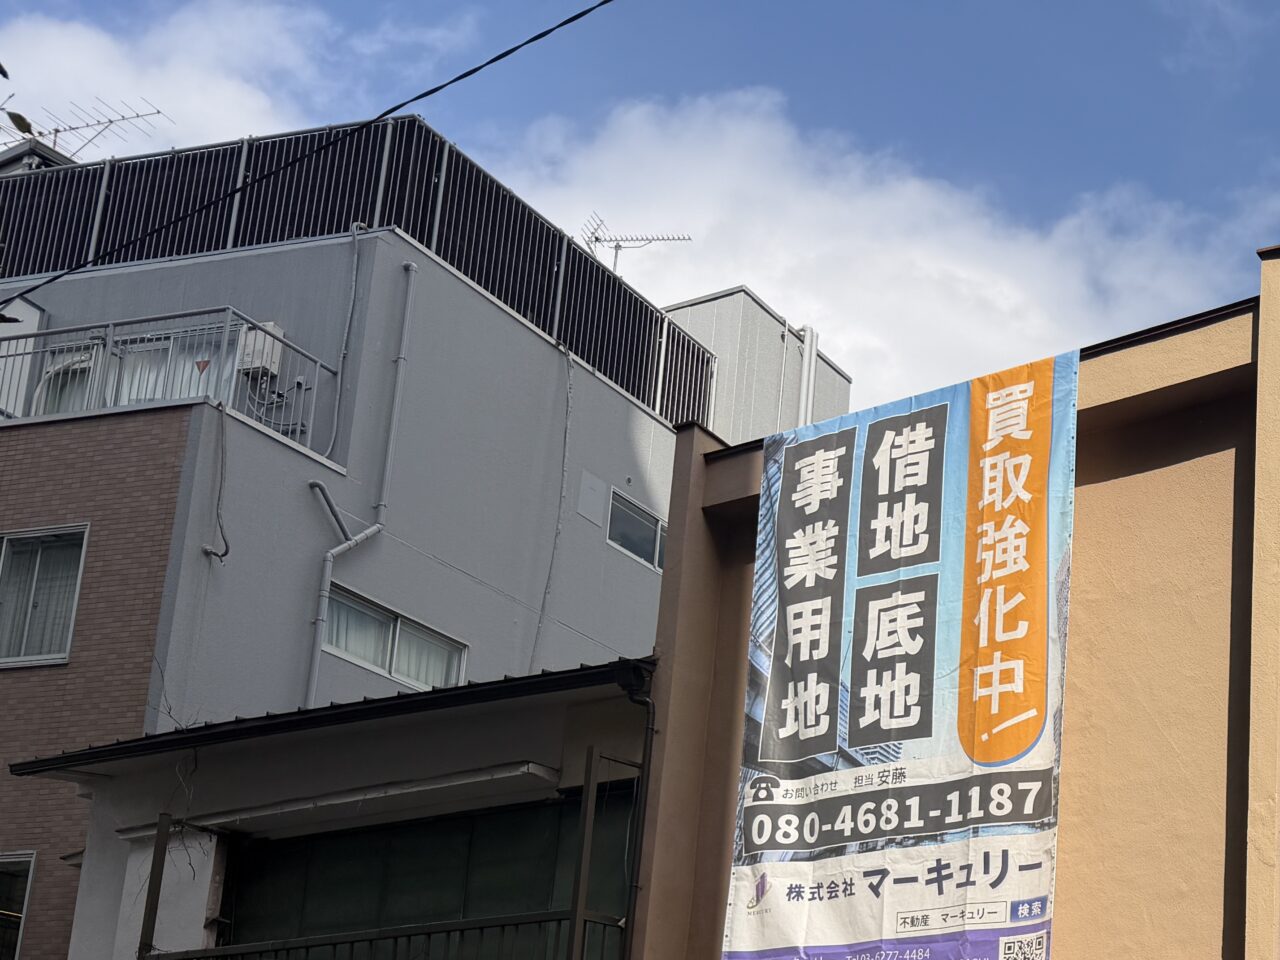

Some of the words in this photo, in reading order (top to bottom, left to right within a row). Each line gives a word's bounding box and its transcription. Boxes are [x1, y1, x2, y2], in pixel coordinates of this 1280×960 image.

[869, 422, 936, 559] 借地
[778, 447, 847, 741] 事業用地
[858, 589, 926, 731] 底地
[751, 781, 1044, 845] 080-4681-1187
[782, 780, 838, 799] お問い合わせ
[899, 914, 930, 929] 不動産
[941, 907, 998, 923] マーキュリー
[1017, 901, 1042, 918] 検索
